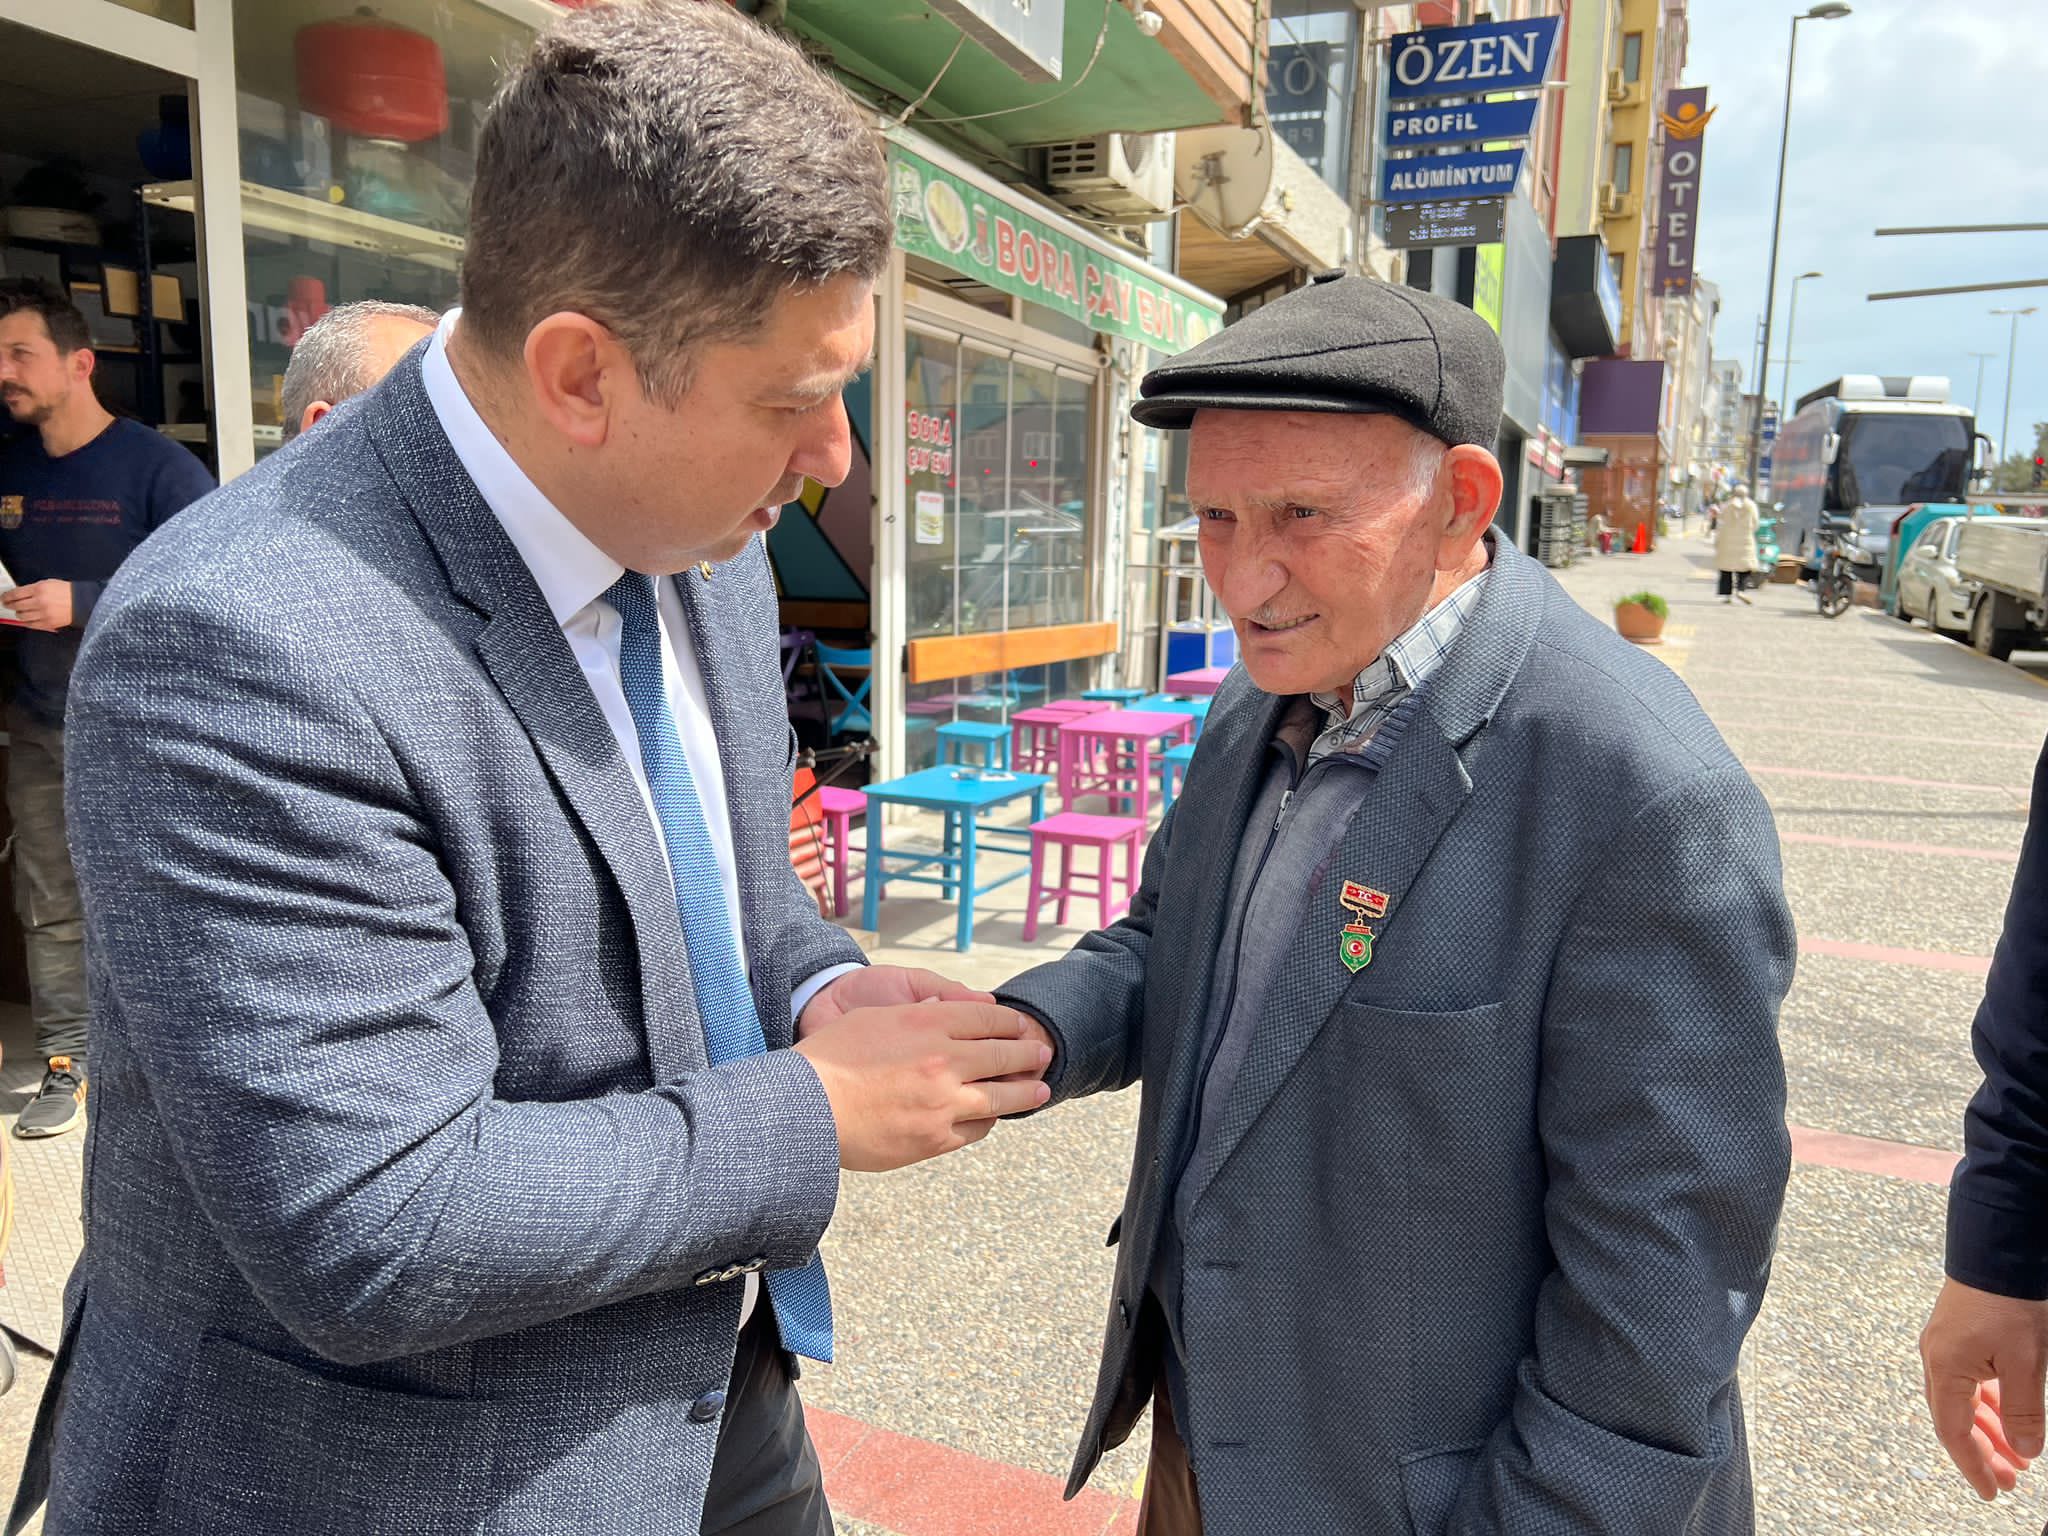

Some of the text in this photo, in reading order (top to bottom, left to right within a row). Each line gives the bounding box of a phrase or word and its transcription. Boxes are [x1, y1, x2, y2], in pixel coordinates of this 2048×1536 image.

[1395, 32, 1540, 86] ÖZEN
[1390, 163, 1514, 191] ALÜMİNYUM
[1667, 151, 1697, 267] OTEL
[994, 215, 1080, 305] BORA
[1082, 263, 1132, 326] ÇAY
[907, 410, 953, 447] BORA
